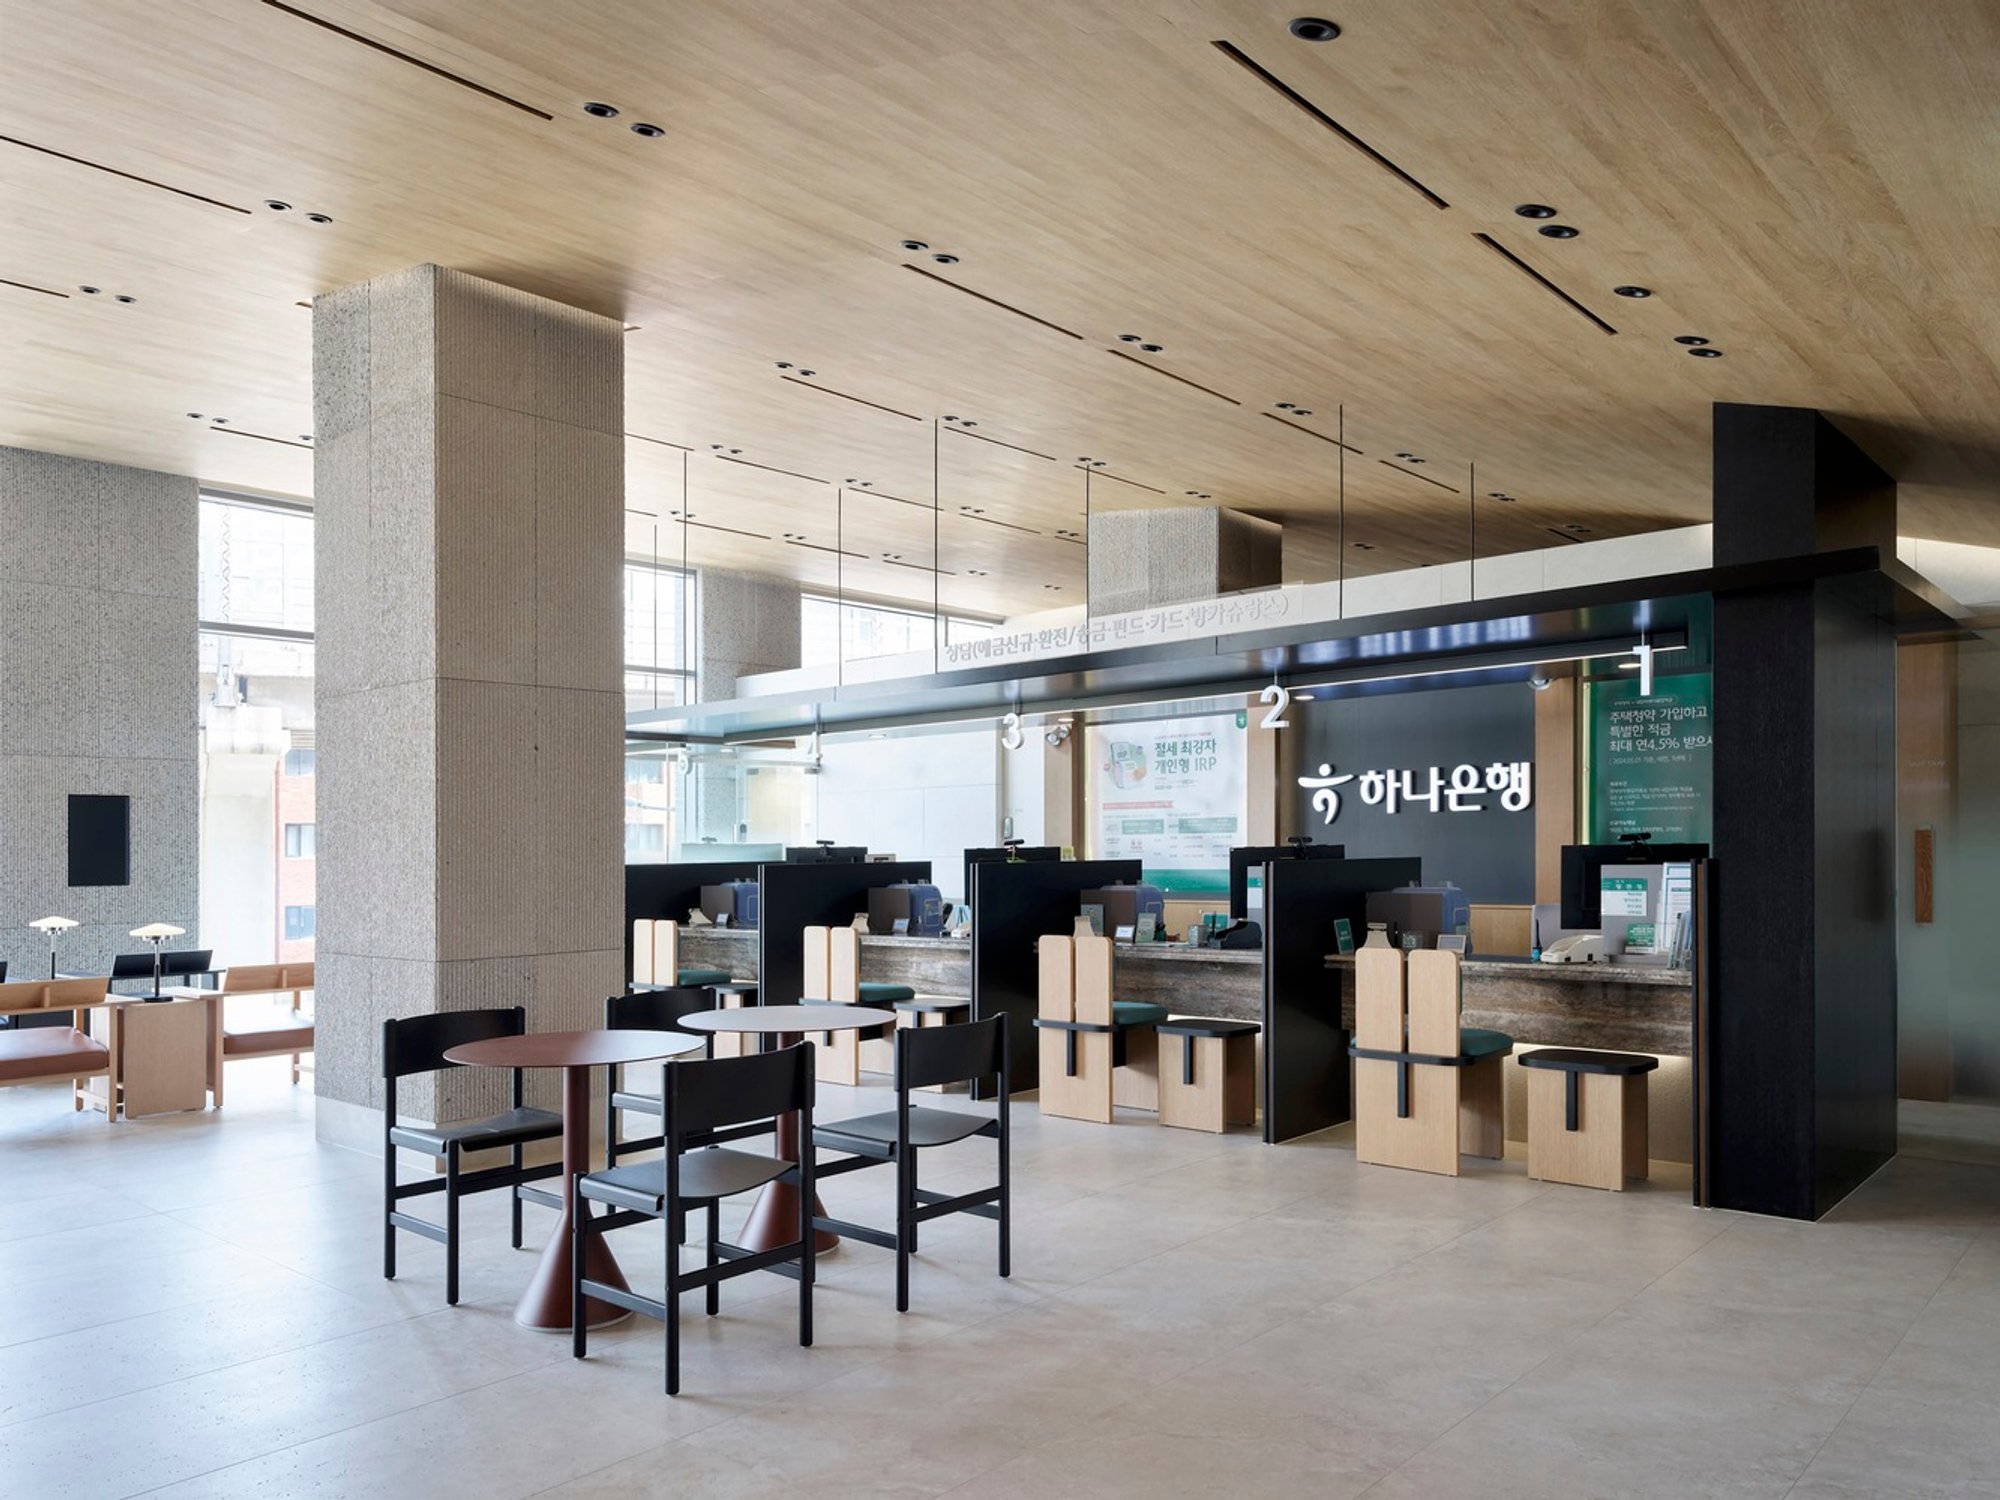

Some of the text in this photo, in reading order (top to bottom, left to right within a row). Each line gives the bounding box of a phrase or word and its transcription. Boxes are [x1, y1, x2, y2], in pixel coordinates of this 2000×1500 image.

[1632, 645, 1651, 696] 1
[1260, 685, 1290, 728] 2
[1610, 706, 1708, 723] 주택청약 가입하고
[1001, 712, 1021, 750] 3
[1610, 723, 1671, 738] 특별한 적금
[1155, 738, 1216, 758] 절세 최강자
[1610, 739, 1632, 752] 최대
[1636, 737, 1680, 752] 연4.5%
[1155, 756, 1217, 774] 개인형 IRP
[1359, 762, 1531, 814] 하나은행
